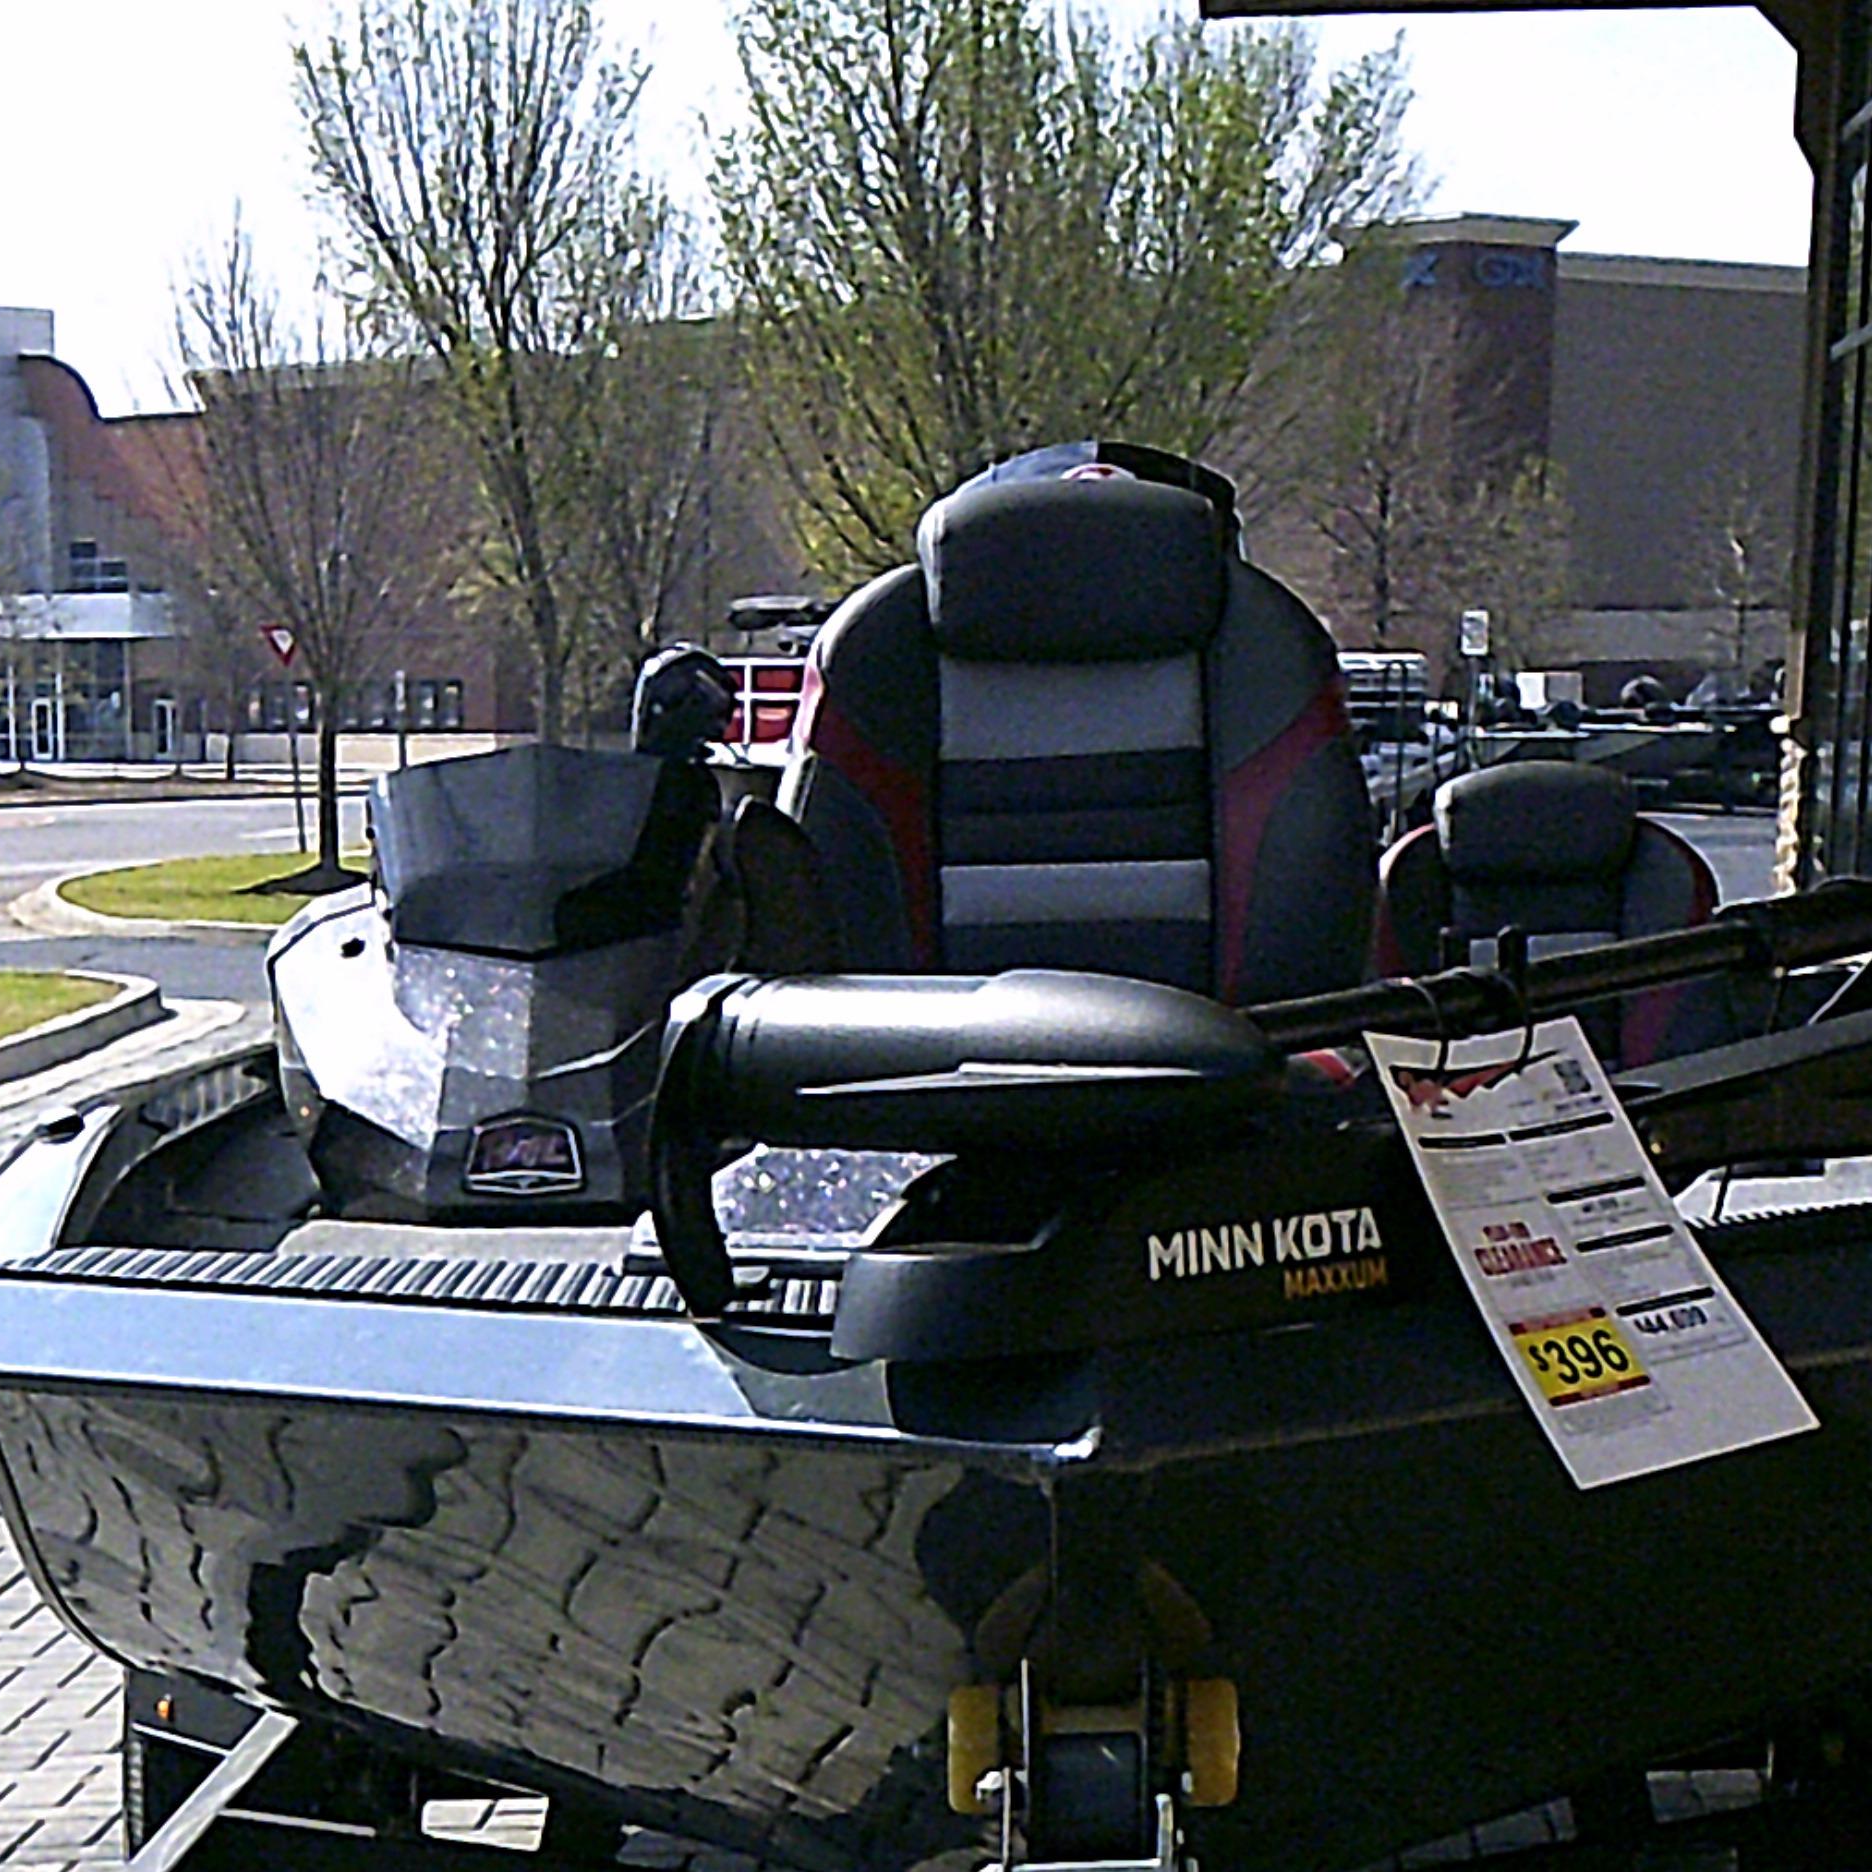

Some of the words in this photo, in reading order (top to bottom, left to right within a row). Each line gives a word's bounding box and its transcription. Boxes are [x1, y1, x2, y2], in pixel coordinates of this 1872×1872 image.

[1147, 1221, 1264, 1281] MINN
[1273, 1206, 1383, 1263] KOTA
[1284, 1256, 1388, 1299] MAXXUM
[1529, 1329, 1629, 1385] $396
